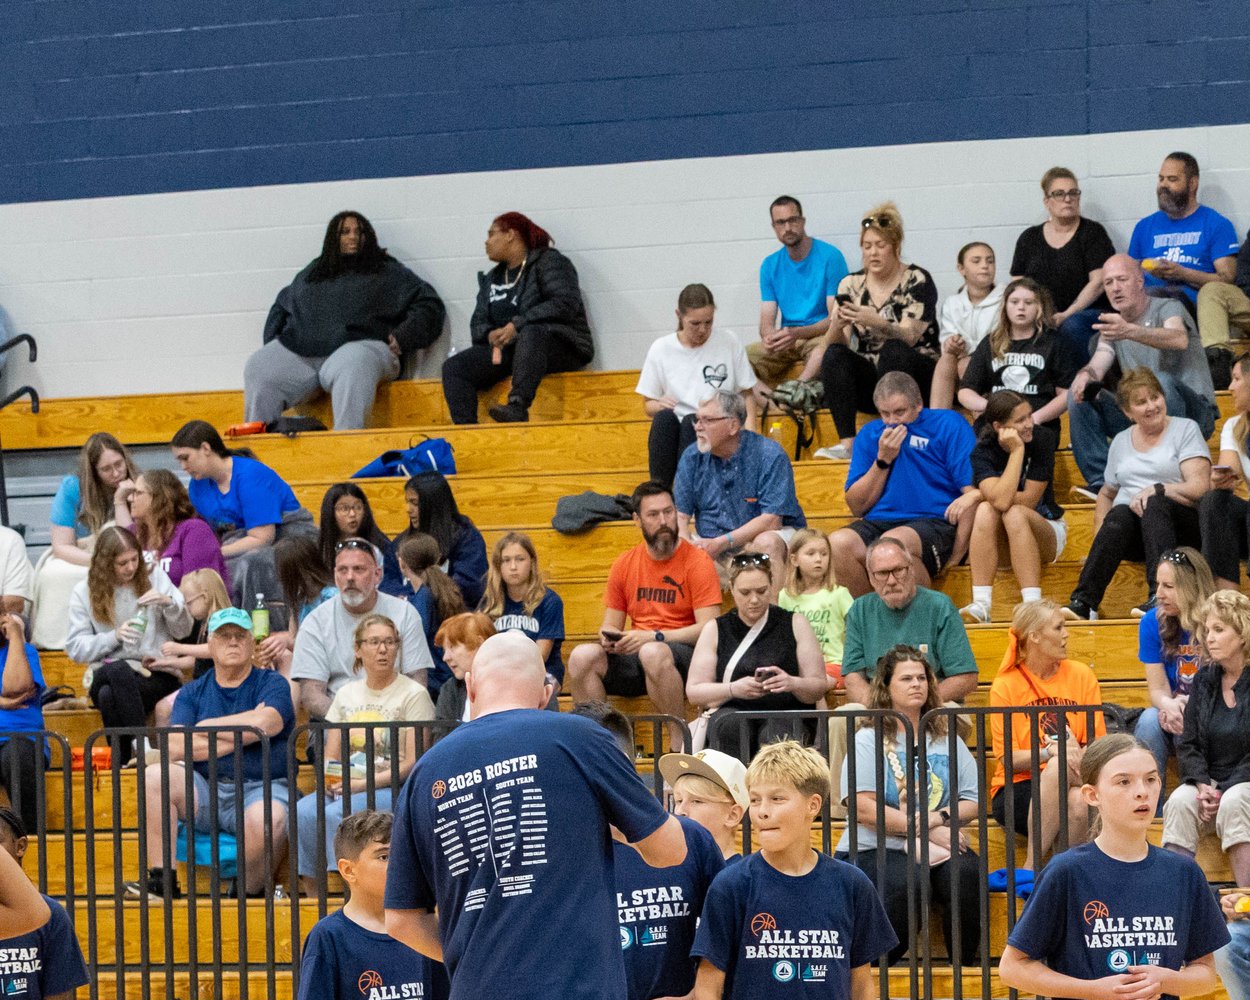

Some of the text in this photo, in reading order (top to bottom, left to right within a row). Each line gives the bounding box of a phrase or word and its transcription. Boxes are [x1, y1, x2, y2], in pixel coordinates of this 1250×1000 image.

[637, 587, 676, 603] PUMA
[448, 754, 538, 793] 2026 ROSTER
[496, 775, 535, 790] SOUTH TEAM
[437, 793, 474, 812] NORTH TEAM
[632, 886, 684, 906] STAR
[618, 903, 690, 924] KETBALL
[1093, 916, 1174, 933] ALL STAR
[760, 929, 839, 944] ALL STAR
